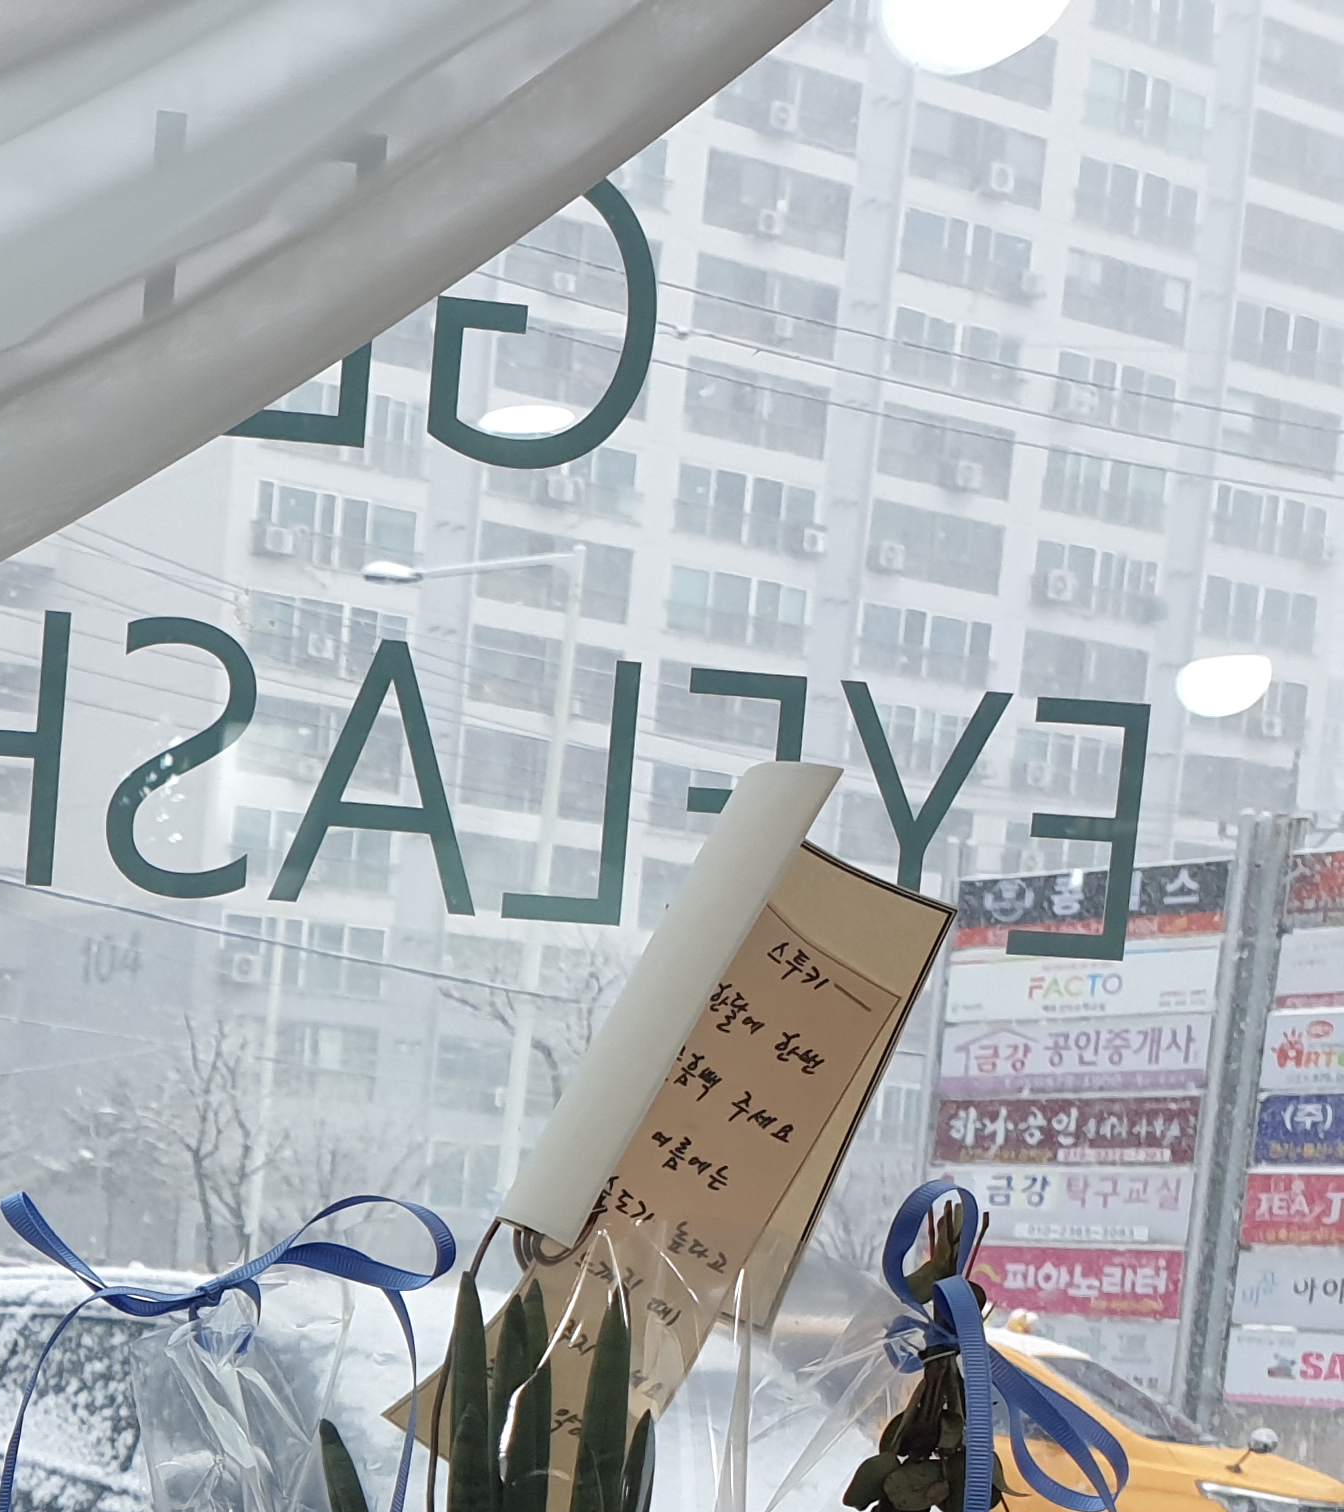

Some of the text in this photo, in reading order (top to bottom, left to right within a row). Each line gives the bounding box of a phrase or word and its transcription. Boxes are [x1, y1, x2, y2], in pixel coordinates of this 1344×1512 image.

[1027, 972, 1123, 1000] FACTO
[973, 1024, 1197, 1074] 금강 공인중개사
[985, 1172, 1182, 1211] 금강 탁구교실
